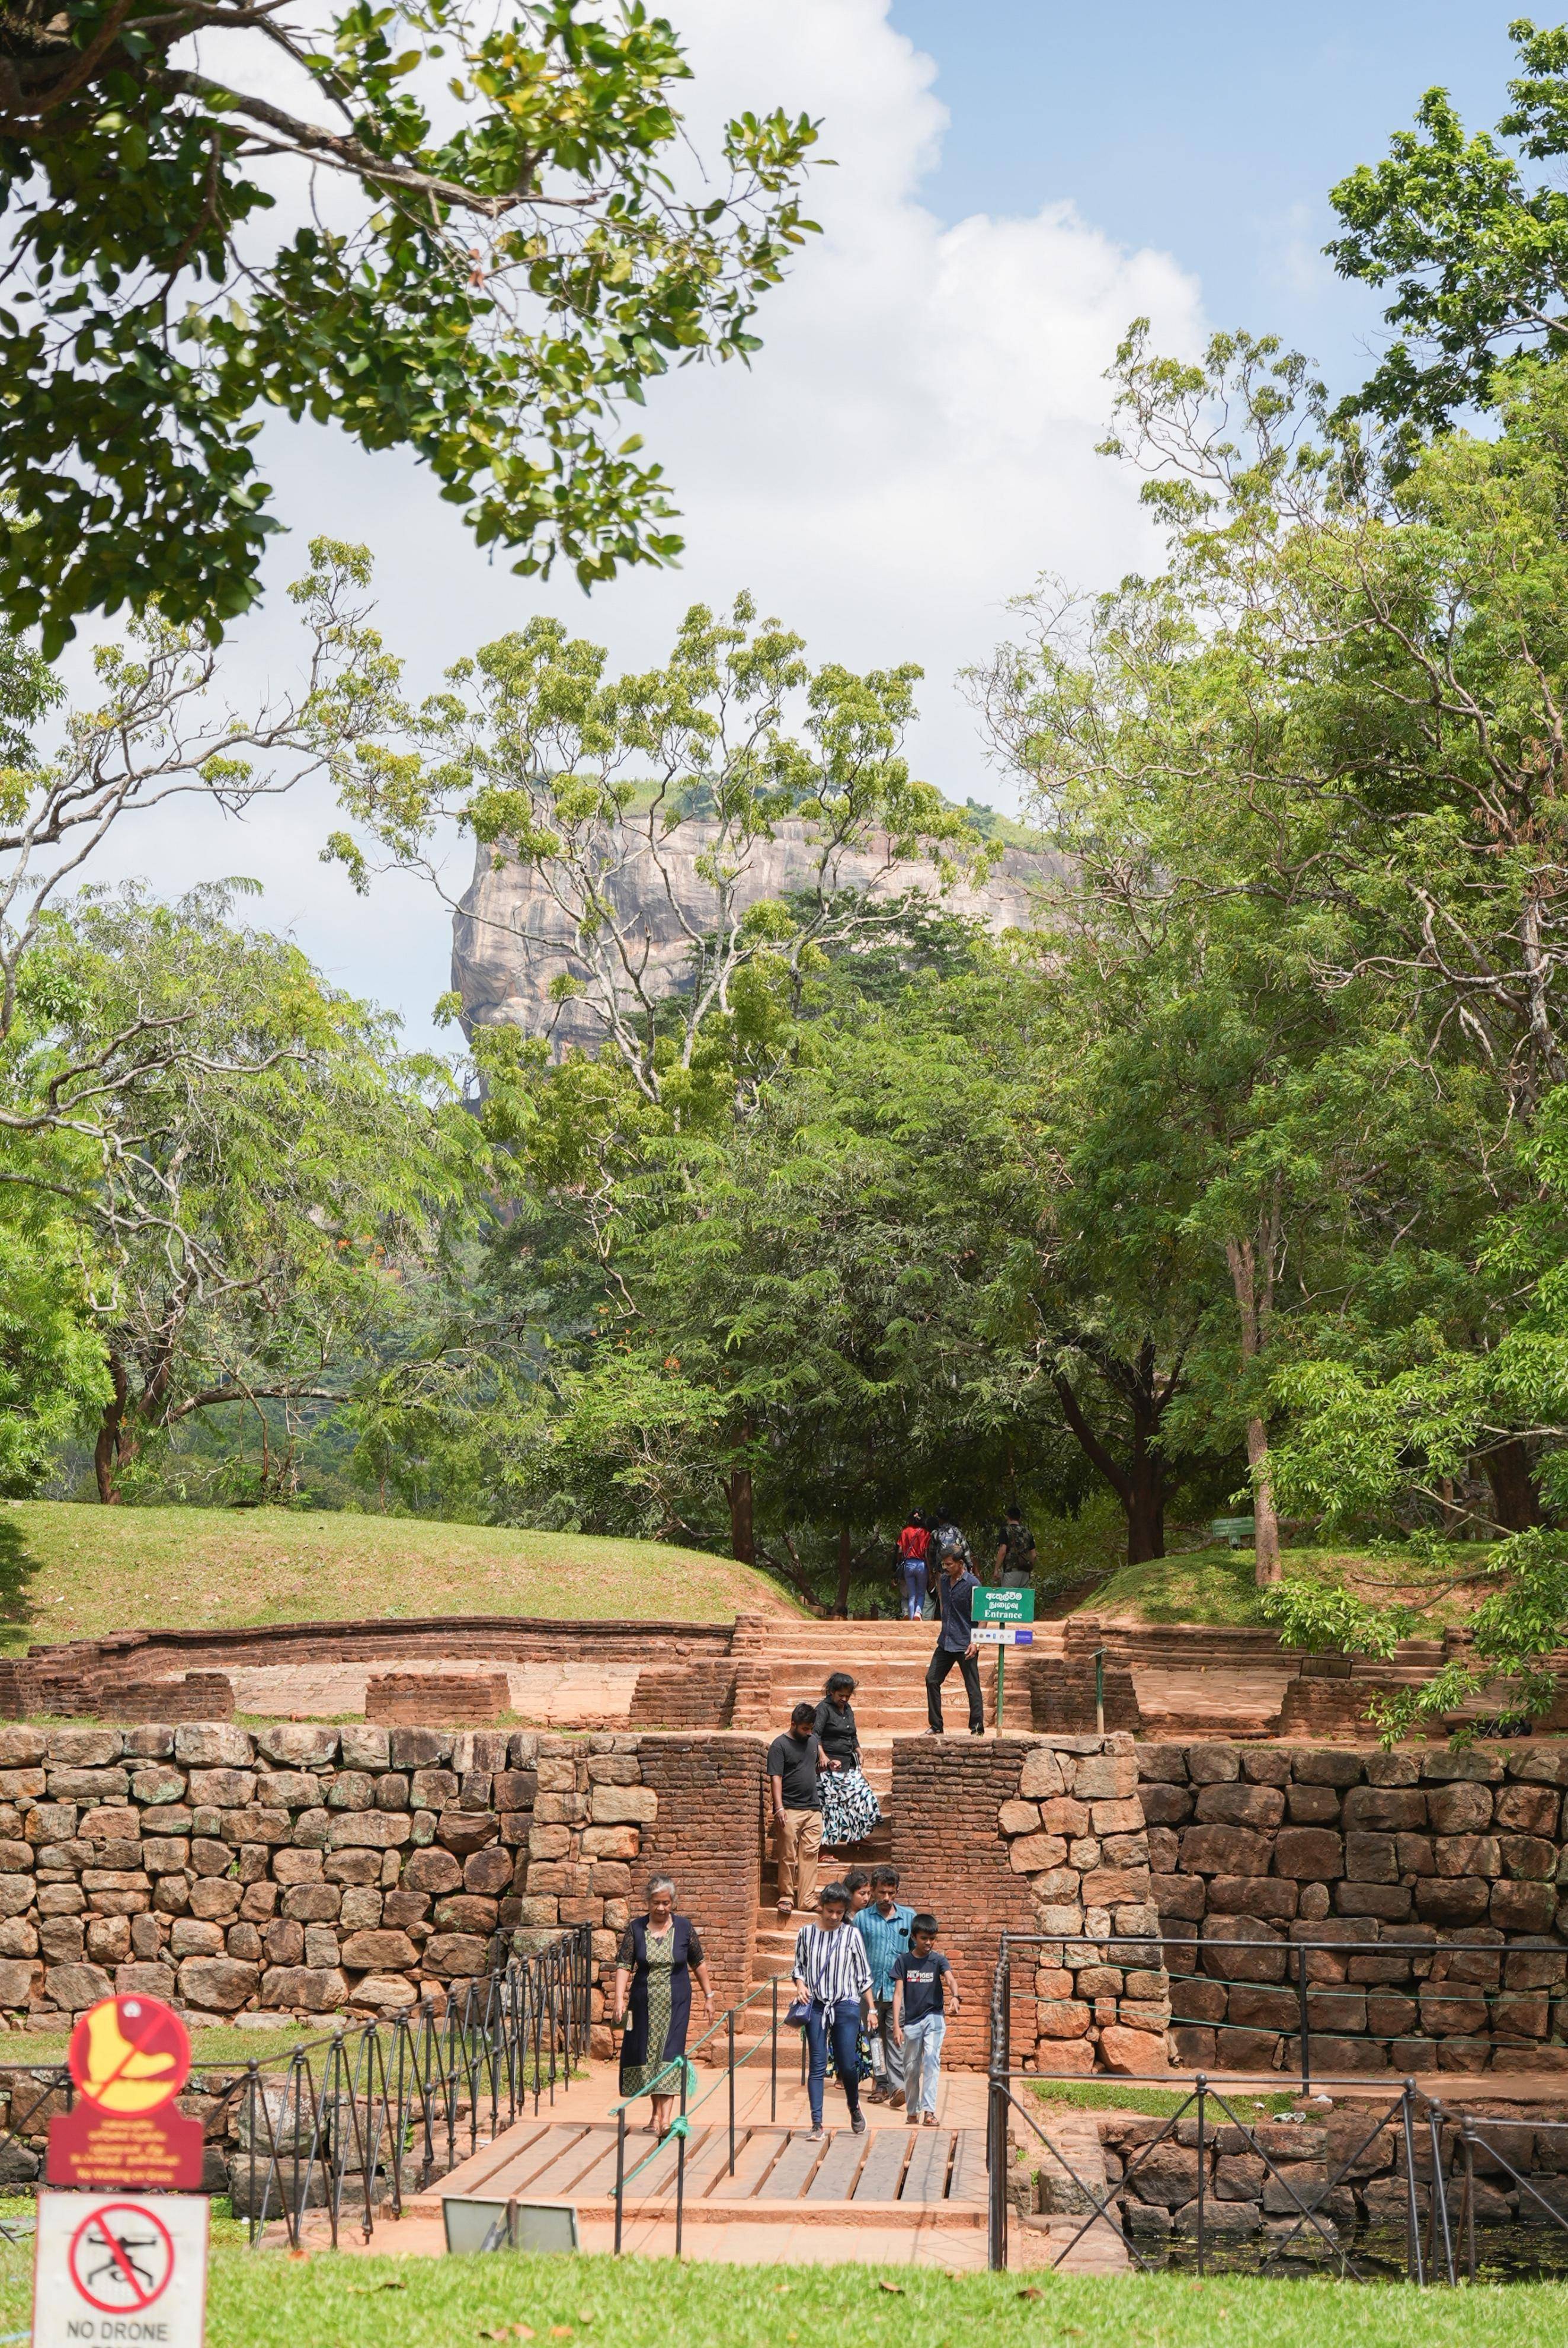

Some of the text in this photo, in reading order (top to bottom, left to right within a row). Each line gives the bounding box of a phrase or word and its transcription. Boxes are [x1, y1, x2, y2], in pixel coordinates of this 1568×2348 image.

[984, 1609, 1022, 1619] Entrance
[67, 2320, 168, 2341] NO DRONE
